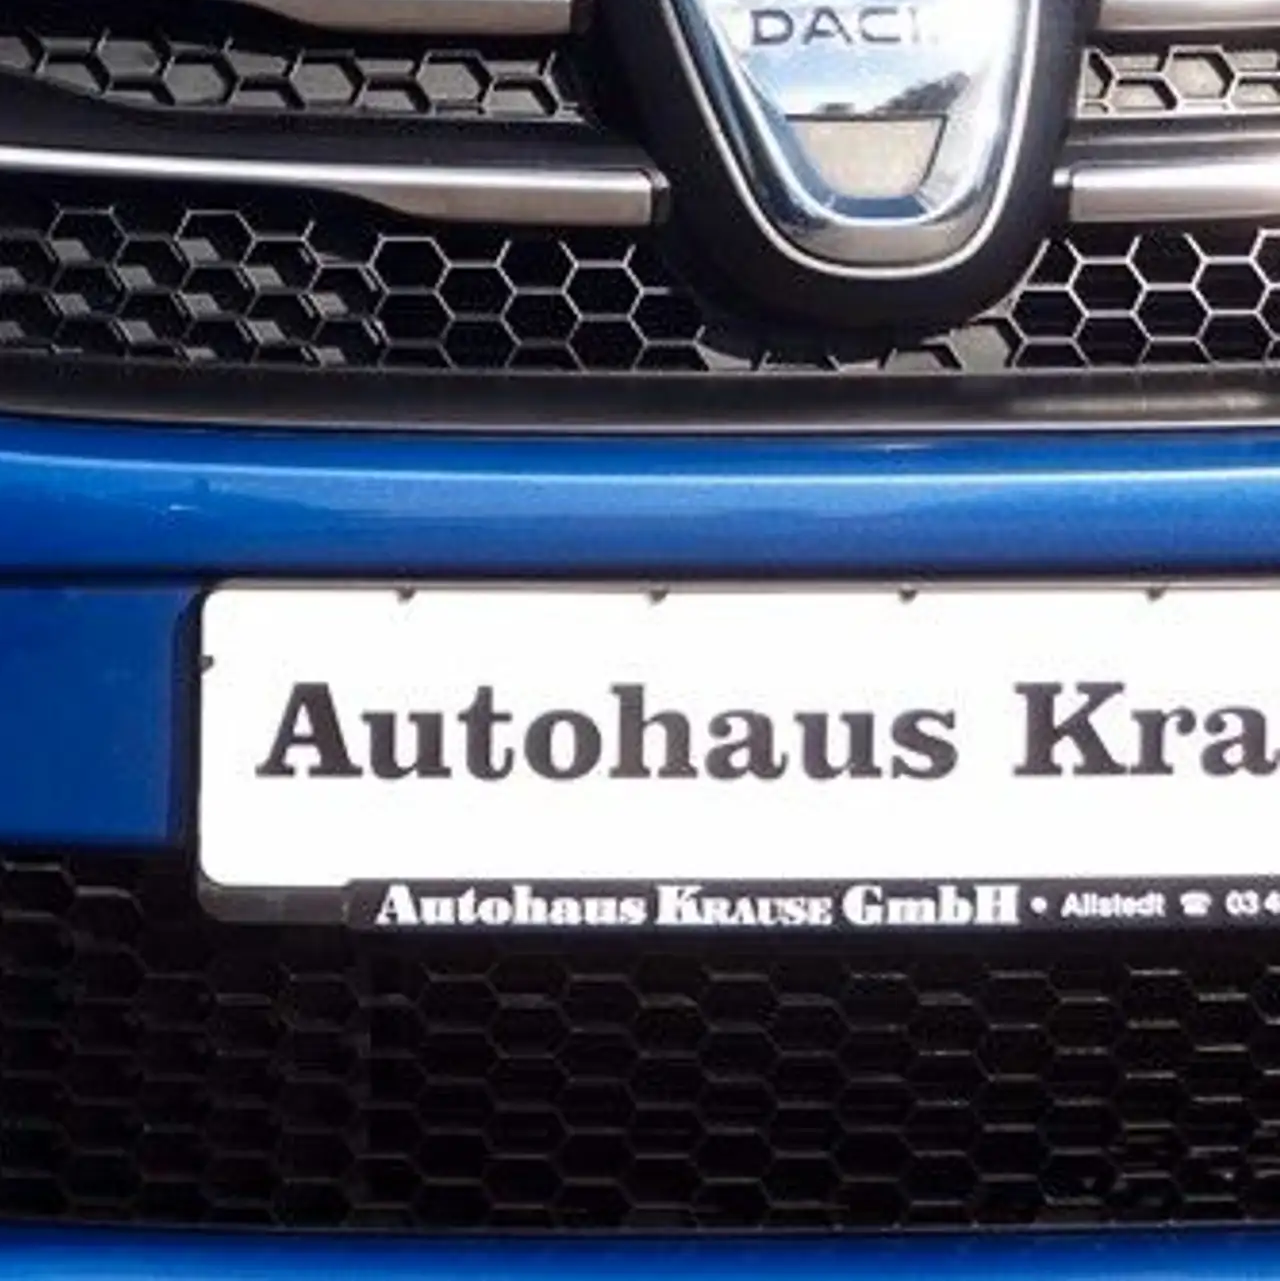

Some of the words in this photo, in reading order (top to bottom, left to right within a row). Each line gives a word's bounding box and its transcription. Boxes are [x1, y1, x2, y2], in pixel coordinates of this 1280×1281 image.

[749, 4, 924, 47] DACI
[255, 681, 959, 782] Autohaus
[375, 884, 644, 925] Autohaus
[841, 884, 1020, 925] GmbH
[1059, 891, 1167, 918] Allstedt
